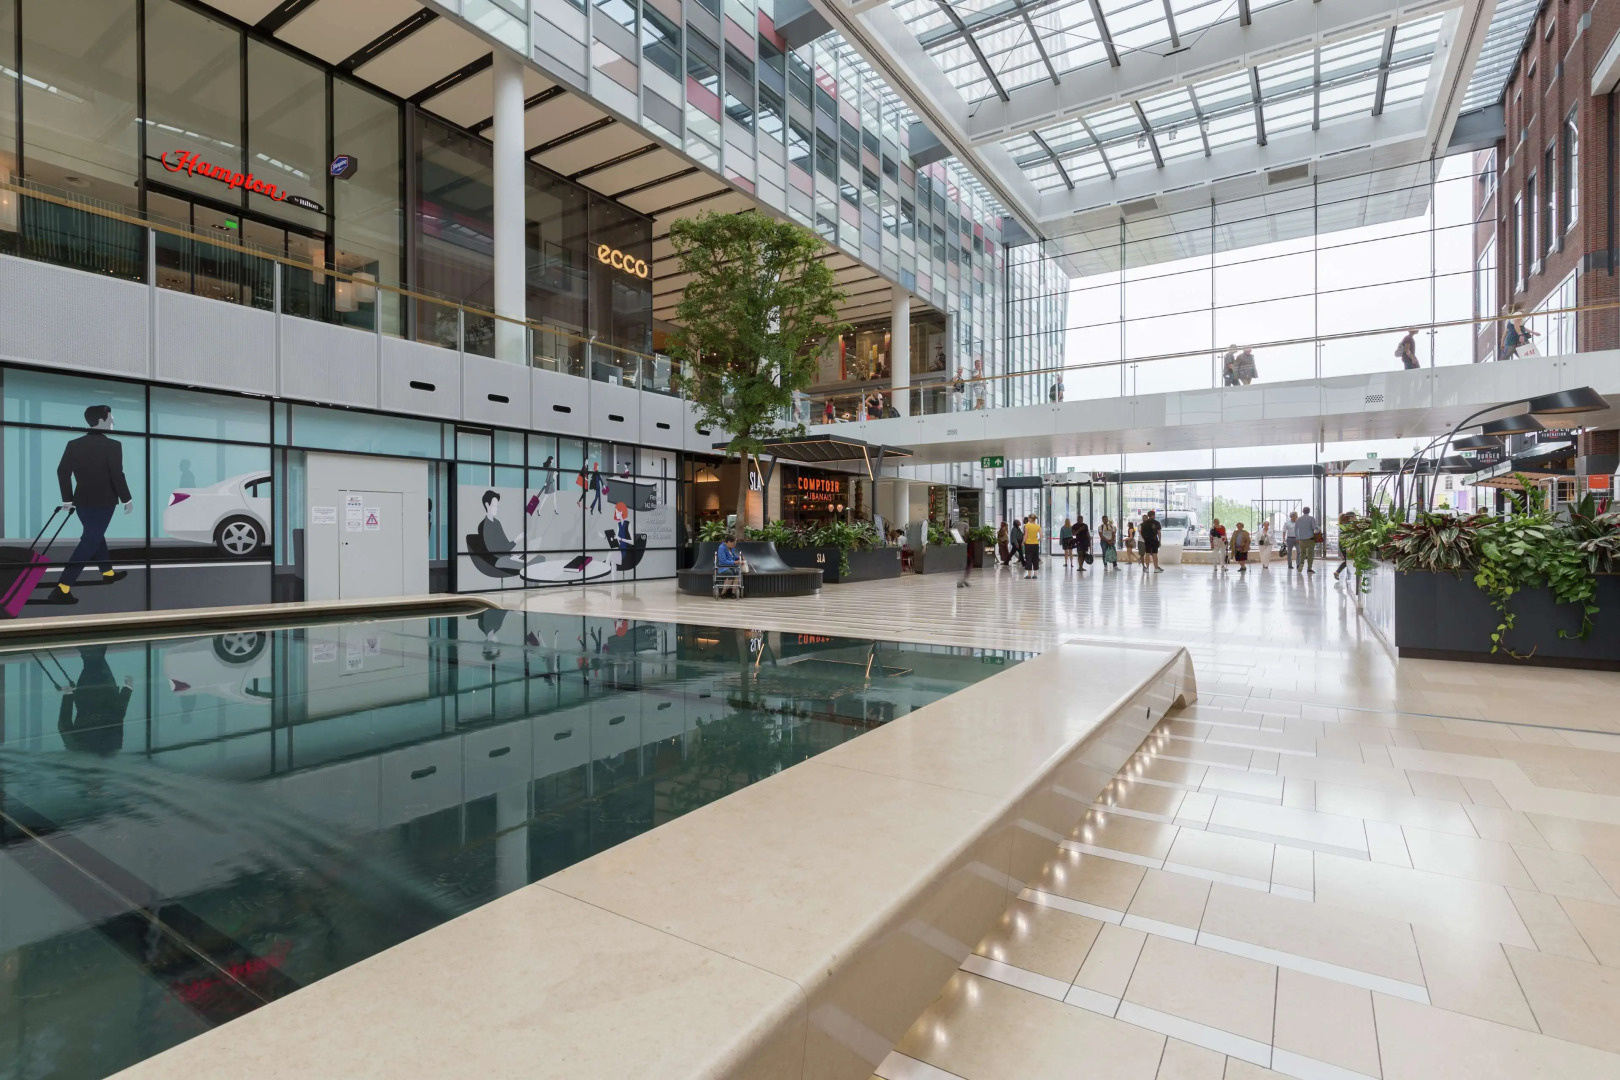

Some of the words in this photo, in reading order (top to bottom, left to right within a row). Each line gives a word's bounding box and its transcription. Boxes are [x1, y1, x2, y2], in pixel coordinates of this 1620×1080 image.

[161, 150, 286, 201] Hampton
[299, 198, 319, 210] Hilton
[597, 244, 648, 278] ecco
[749, 471, 762, 491] SLA
[797, 477, 840, 493] COMPTOIR
[816, 553, 826, 563] SLA
